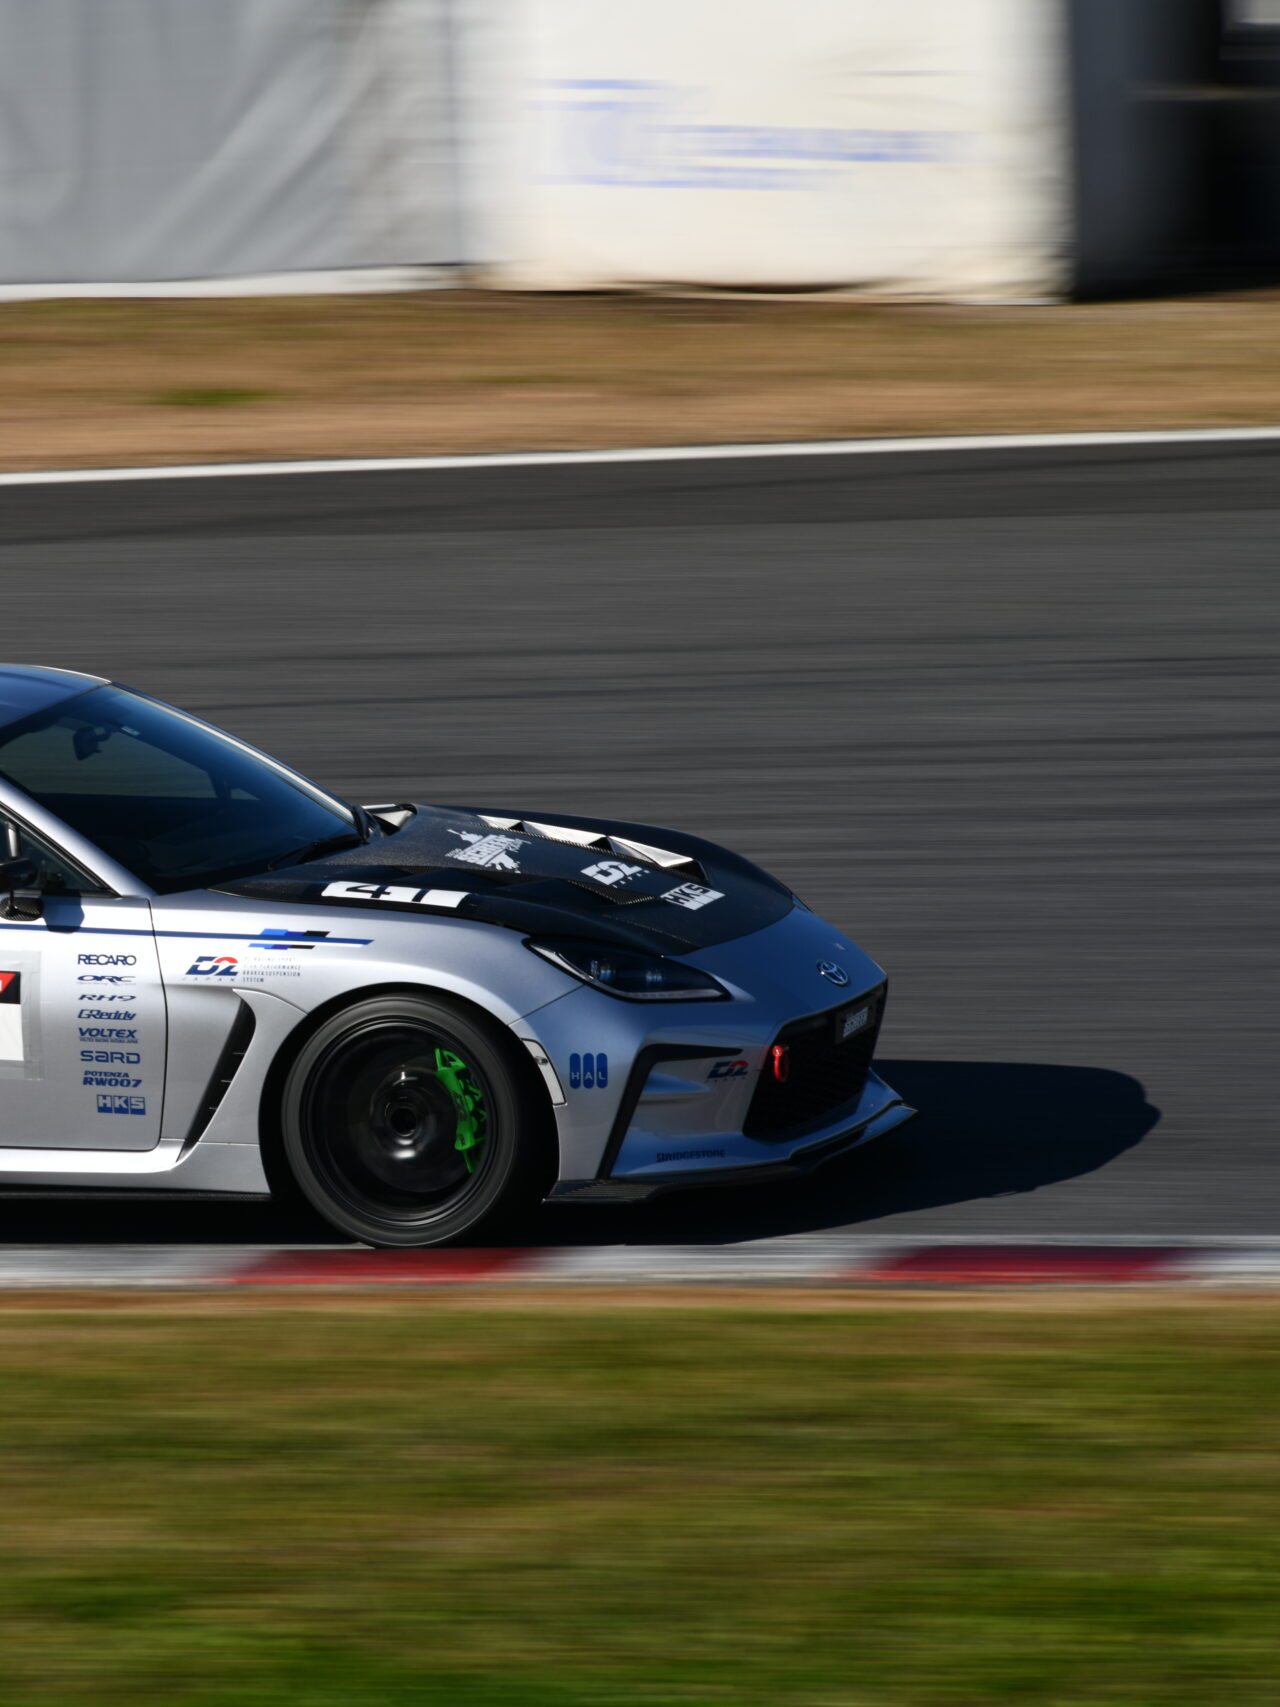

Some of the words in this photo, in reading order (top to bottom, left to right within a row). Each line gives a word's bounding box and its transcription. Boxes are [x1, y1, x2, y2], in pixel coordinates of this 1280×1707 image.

[660, 882, 725, 910] HKS
[78, 954, 136, 965] RECARO
[185, 956, 239, 976] D2
[77, 975, 136, 983] ORC
[77, 1009, 136, 1020] GReddy
[78, 1027, 138, 1039] VOLTEX
[84, 1070, 130, 1078] POTENZA
[83, 1077, 142, 1088] RW007
[97, 1094, 146, 1114] HKS
